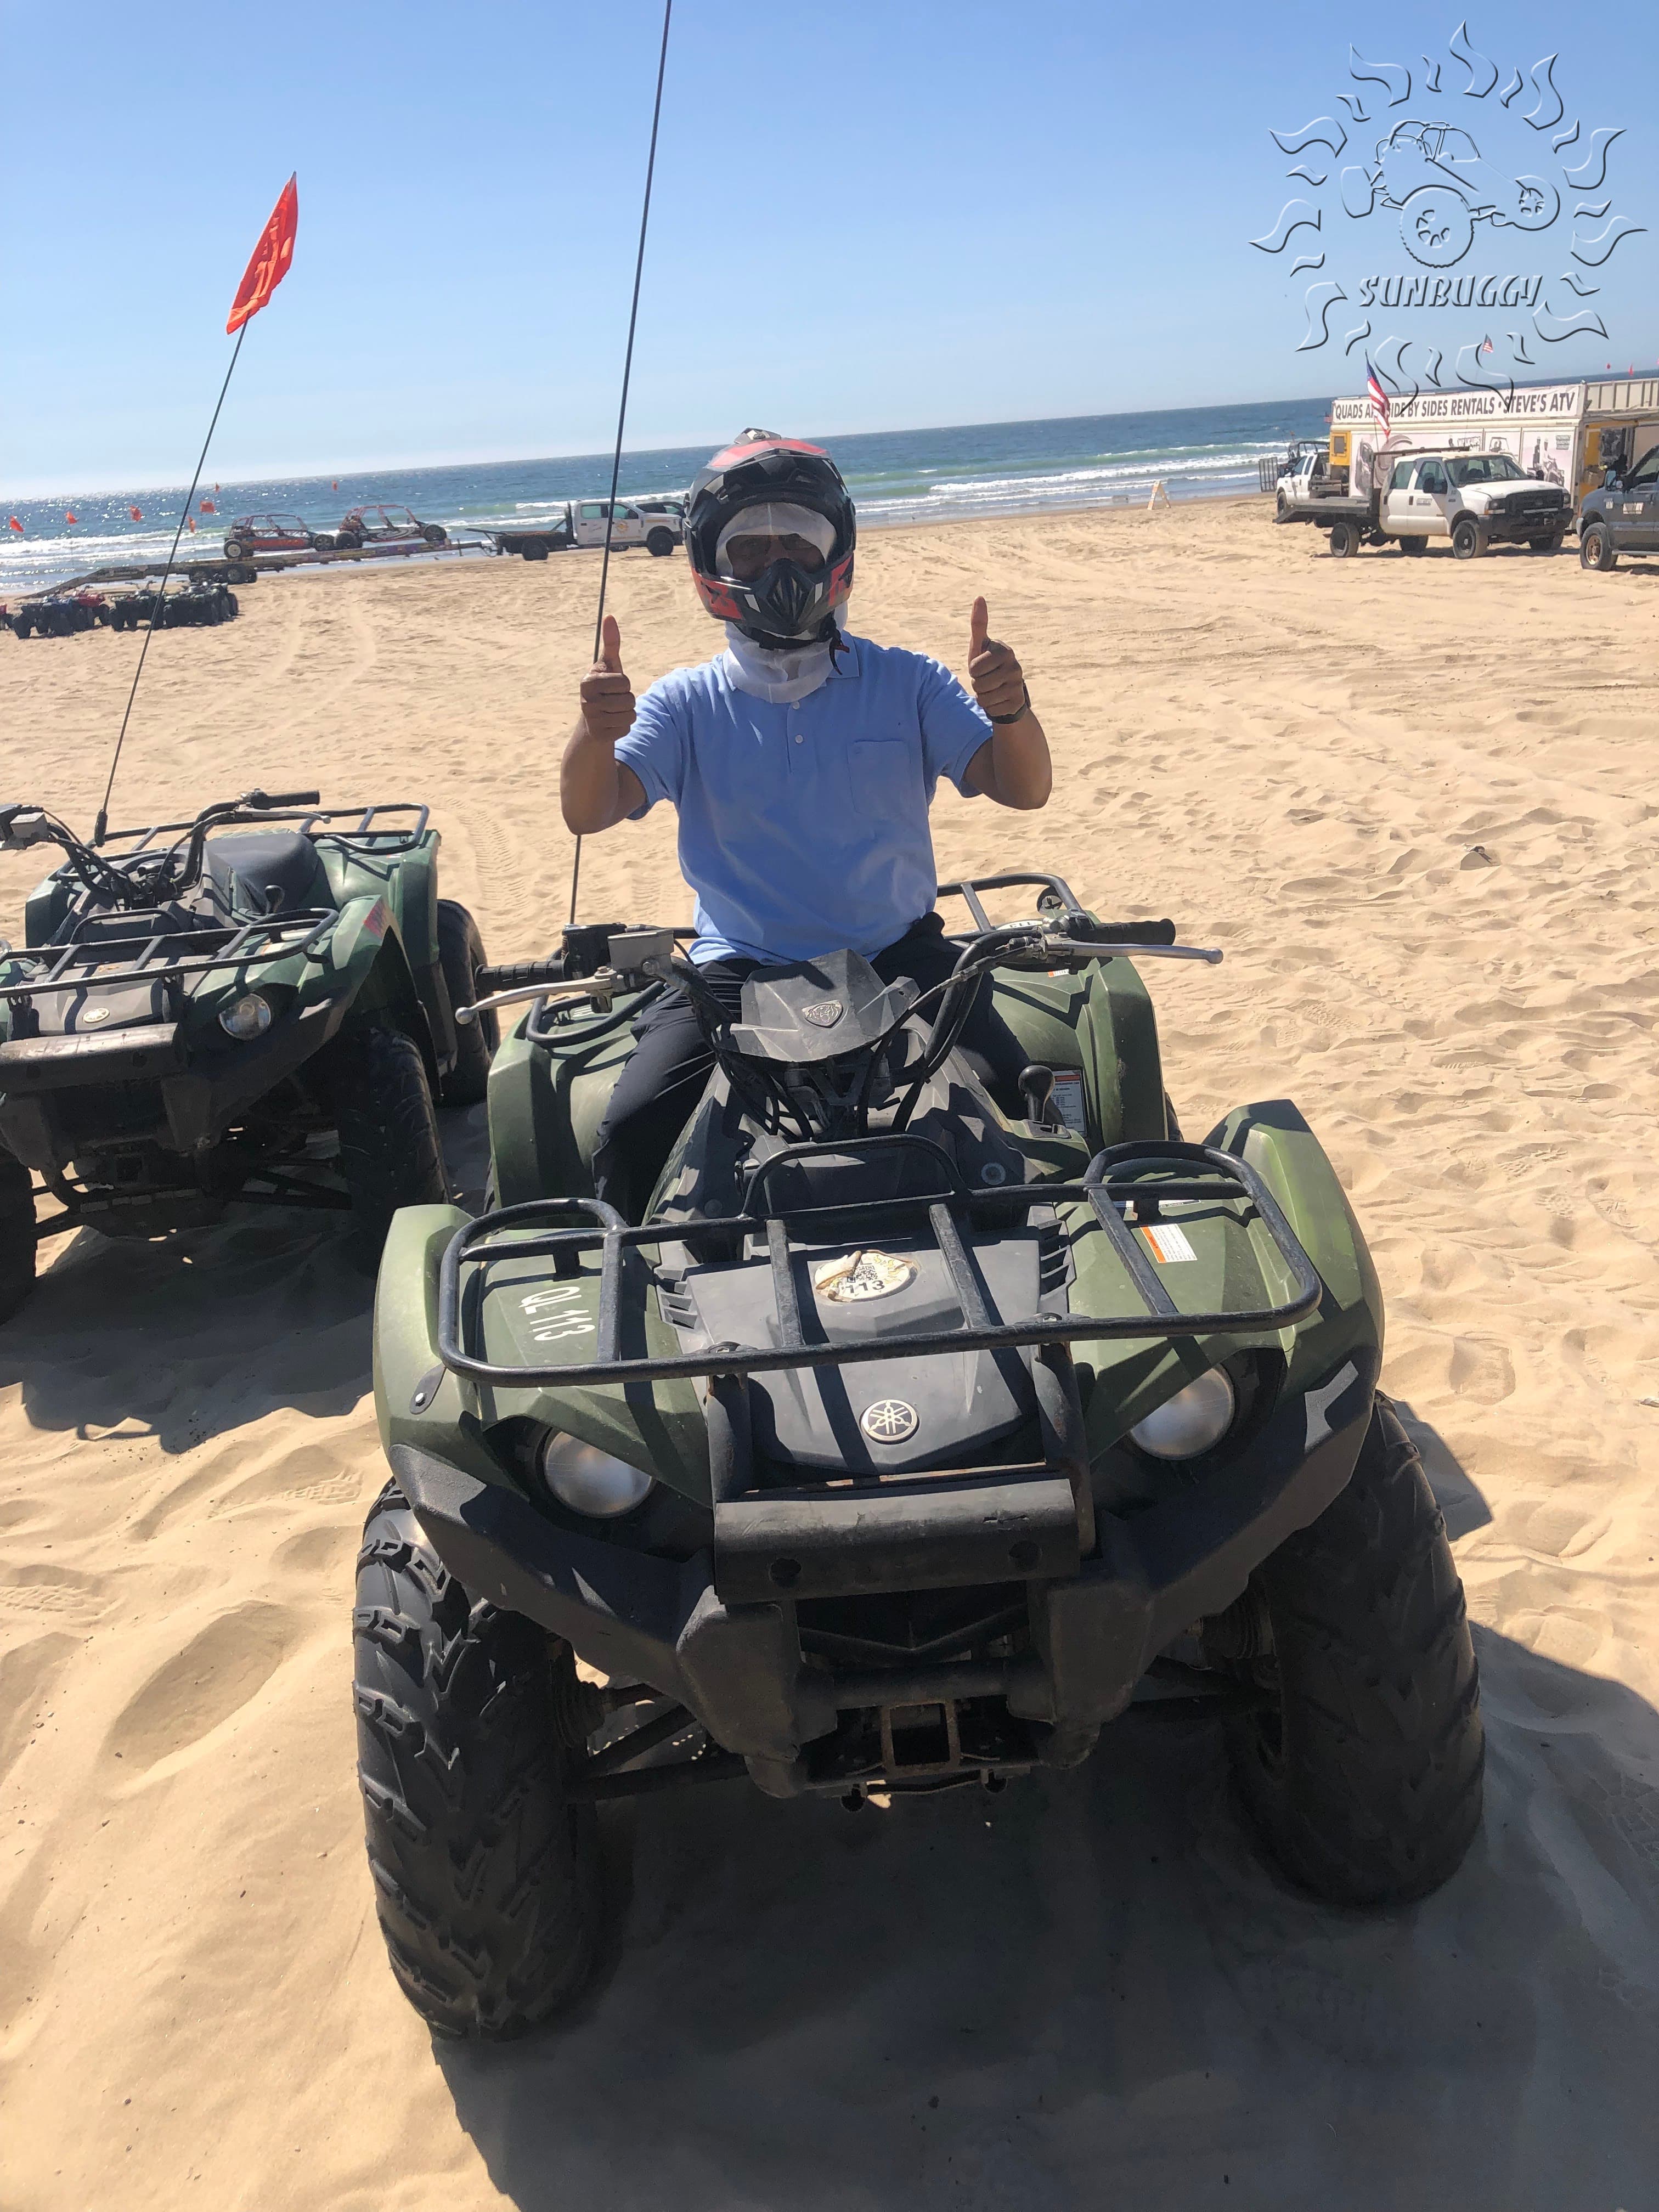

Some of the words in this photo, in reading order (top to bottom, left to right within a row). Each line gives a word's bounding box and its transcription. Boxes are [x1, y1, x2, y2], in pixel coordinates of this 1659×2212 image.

[1335, 404, 1363, 420] QUADS
[1408, 401, 1420, 417] BY
[1421, 399, 1448, 417] SIDES
[1451, 397, 1495, 416] RENTALS
[1503, 393, 1547, 414] STEVE'S
[1549, 392, 1576, 412] ATV
[518, 1286, 582, 1314] QL
[530, 1310, 595, 1341] 113
